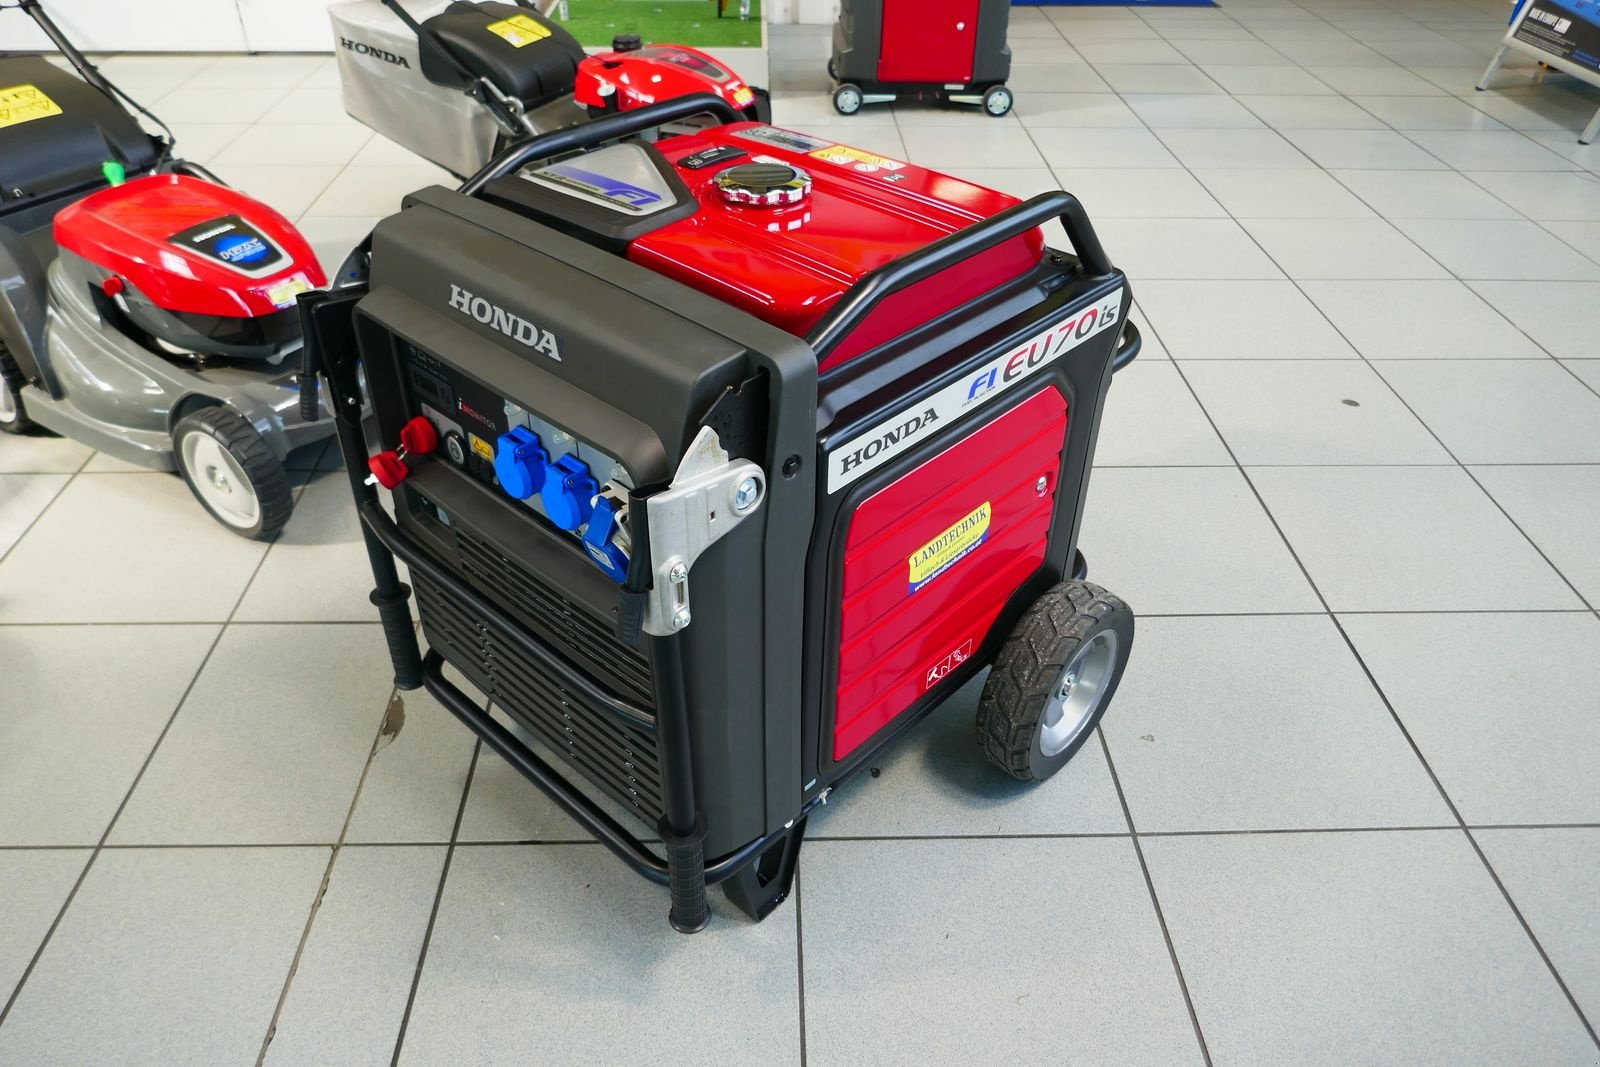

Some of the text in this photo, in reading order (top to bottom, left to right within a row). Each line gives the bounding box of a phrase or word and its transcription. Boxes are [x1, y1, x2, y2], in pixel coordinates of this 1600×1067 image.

[341, 37, 411, 69] HONDA
[448, 284, 562, 362] HONDA
[840, 407, 940, 476] HONDA
[967, 367, 998, 400] FI
[913, 507, 987, 568] LANDTECHNIK
